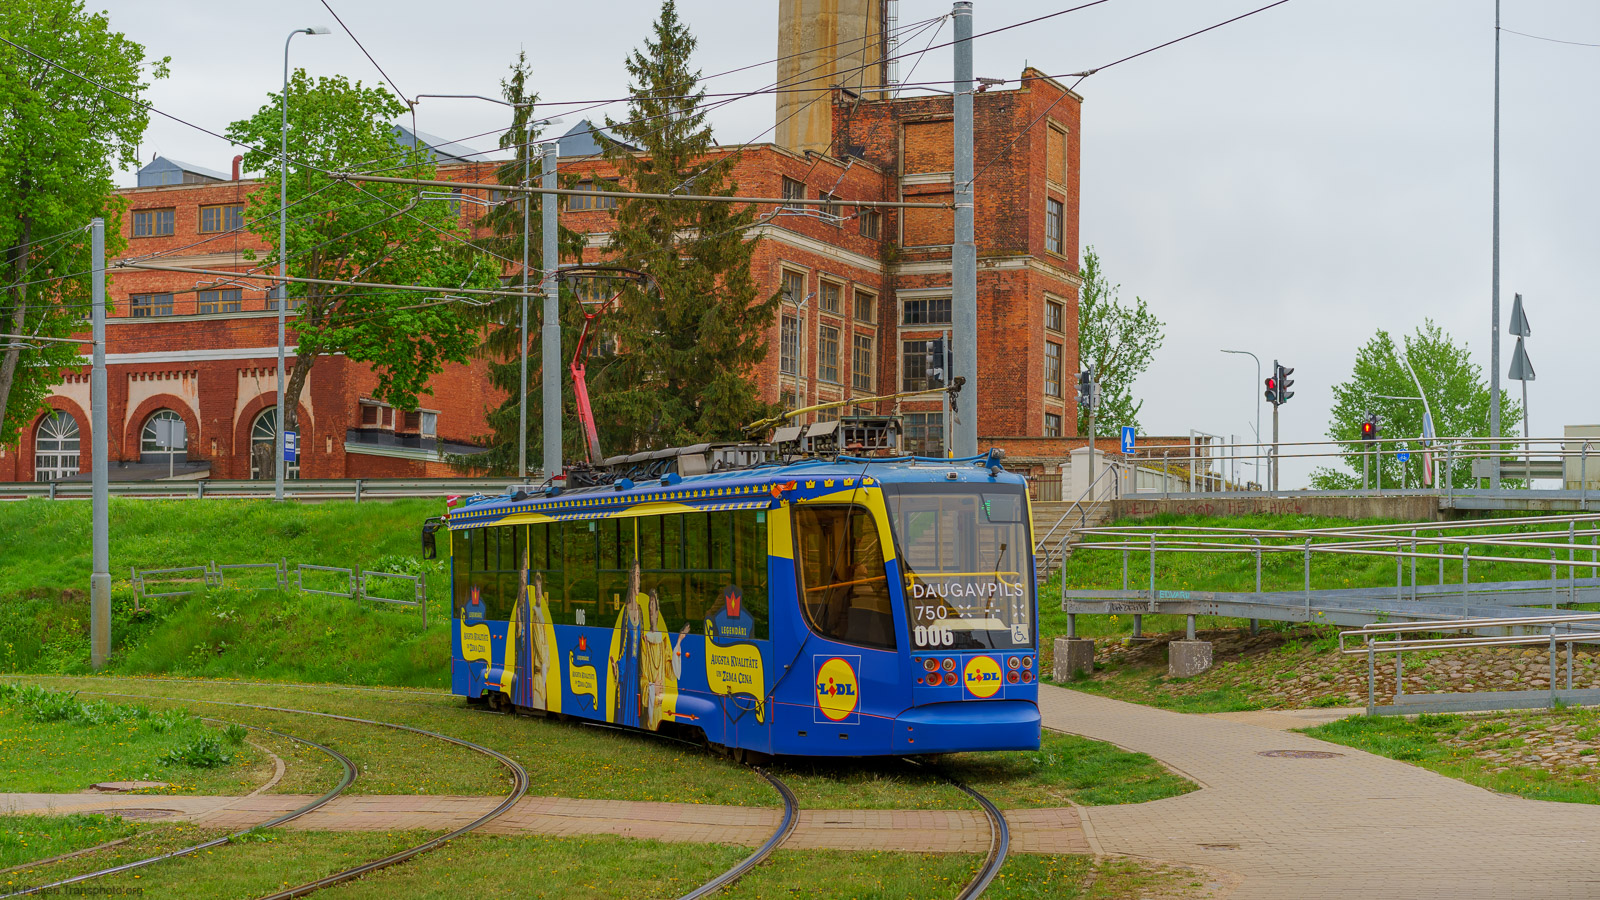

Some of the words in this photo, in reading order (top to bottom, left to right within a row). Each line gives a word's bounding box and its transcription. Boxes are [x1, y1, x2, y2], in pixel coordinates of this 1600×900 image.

[913, 582, 1024, 599] DAUGAVPILS
[576, 609, 586, 625] 006
[914, 605, 948, 621] 750
[914, 624, 954, 647] 006
[711, 654, 730, 665] AUGSTA
[730, 656, 758, 669] KVALITĀTE
[722, 671, 737, 682] ZEMA
[738, 672, 752, 684] CENA
